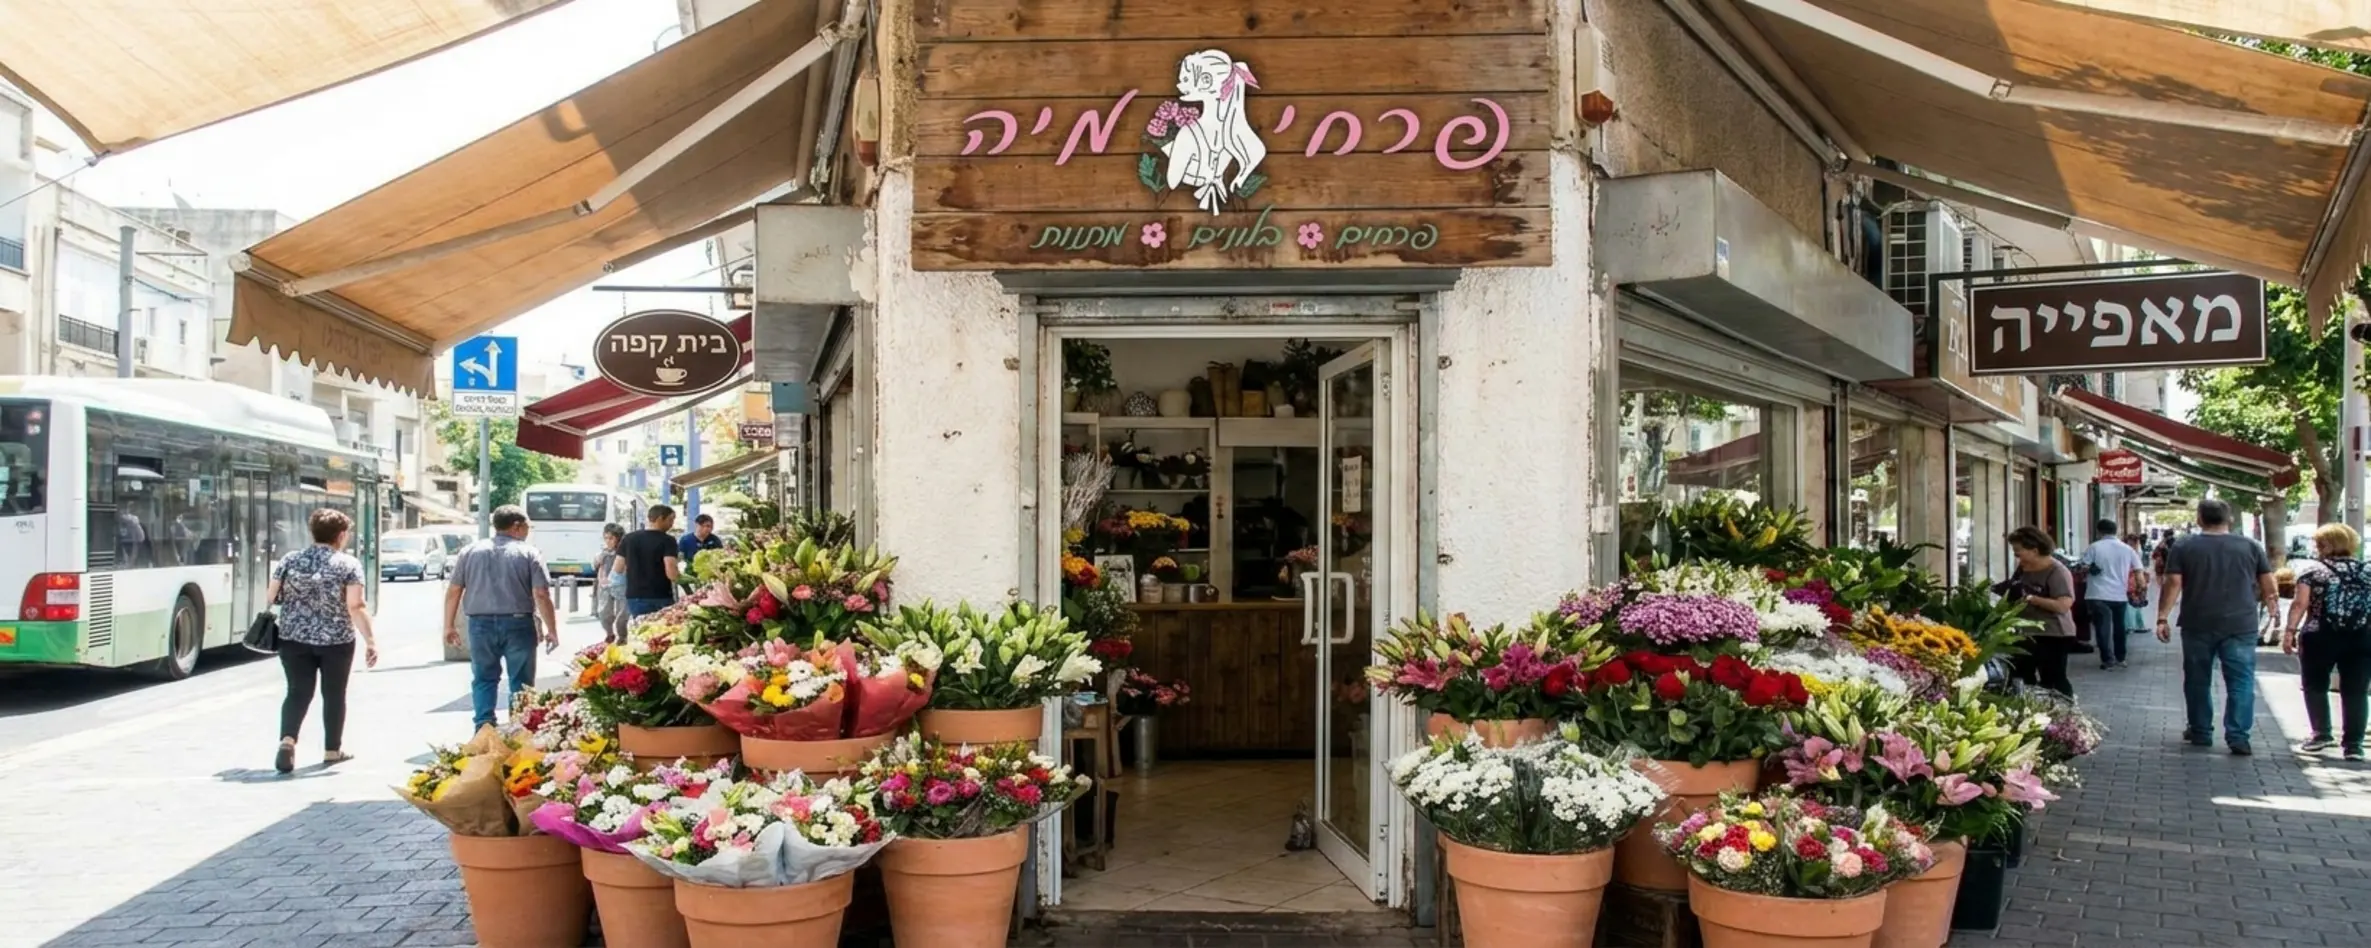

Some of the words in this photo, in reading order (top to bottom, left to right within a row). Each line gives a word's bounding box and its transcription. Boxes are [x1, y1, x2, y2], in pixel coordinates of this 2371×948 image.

[959, 88, 1140, 166] מיה
[1272, 97, 1511, 171] פרחי
[1029, 221, 1129, 251] מתנות
[1188, 204, 1284, 251] בלונים
[1335, 223, 1439, 250] פרחים
[1990, 294, 2242, 353] מאפייה
[610, 334, 668, 359] קפה
[676, 334, 728, 353] בית
